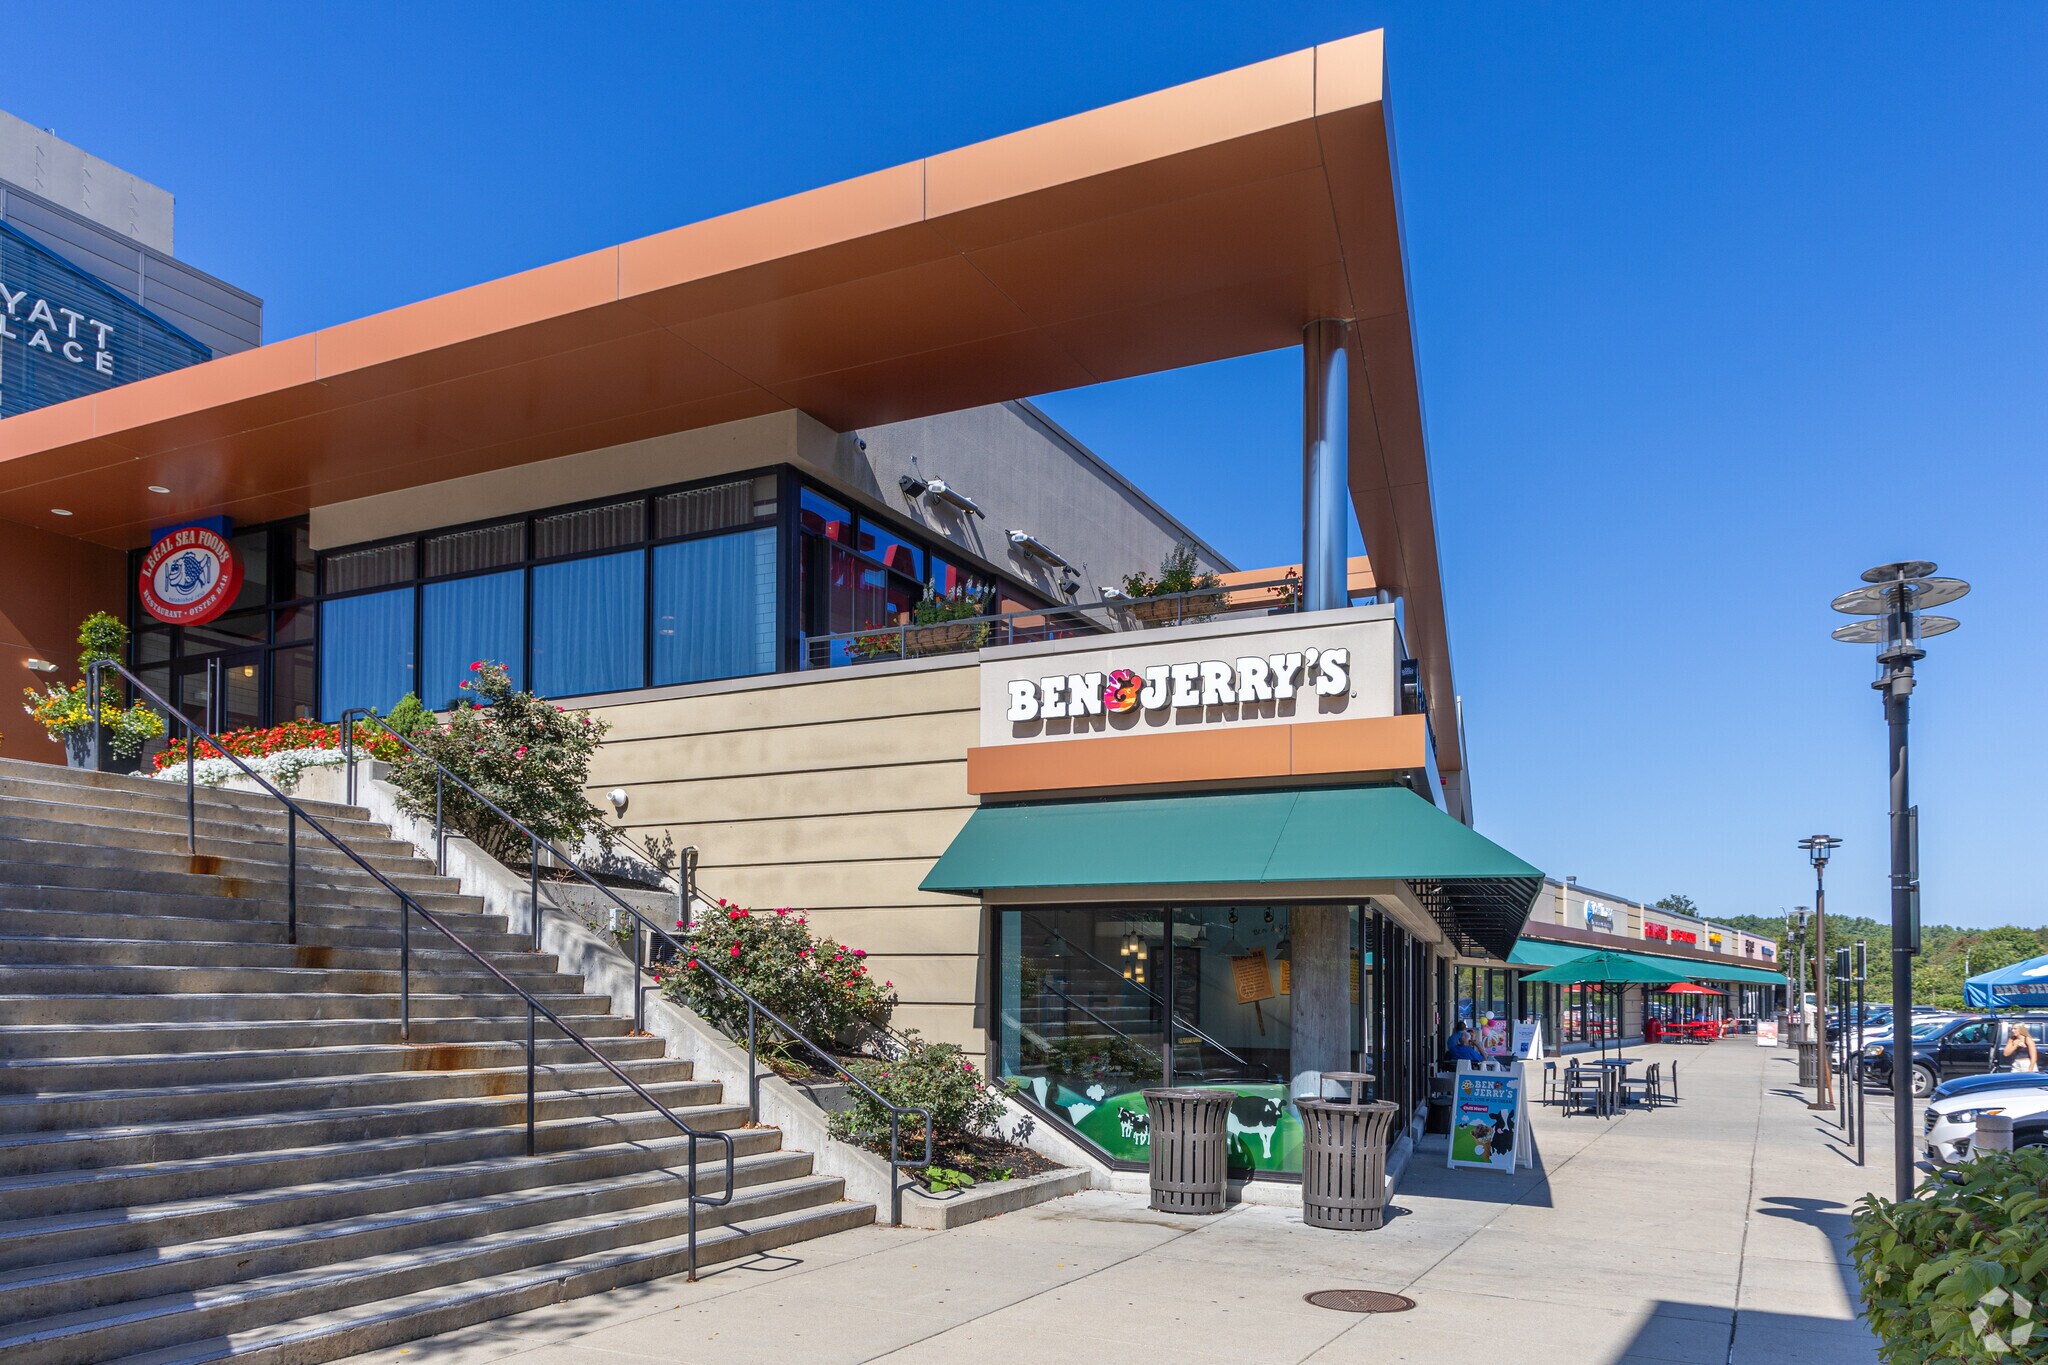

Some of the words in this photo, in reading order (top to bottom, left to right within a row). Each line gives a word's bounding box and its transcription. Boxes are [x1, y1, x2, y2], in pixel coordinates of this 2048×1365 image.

[142, 538, 174, 578] LEGAL
[175, 530, 195, 547] SEA
[198, 530, 230, 563] FOODS
[143, 589, 182, 618] RESTAURANT
[189, 594, 217, 616] OYSTER
[215, 574, 228, 595] BAR
[1007, 671, 1105, 722] BEN
[1140, 647, 1352, 710] JERRY'S
[1993, 985, 2020, 995] BEN
[1473, 1088, 1513, 1099] JERRY'S
[1474, 1080, 1495, 1090] BEN
